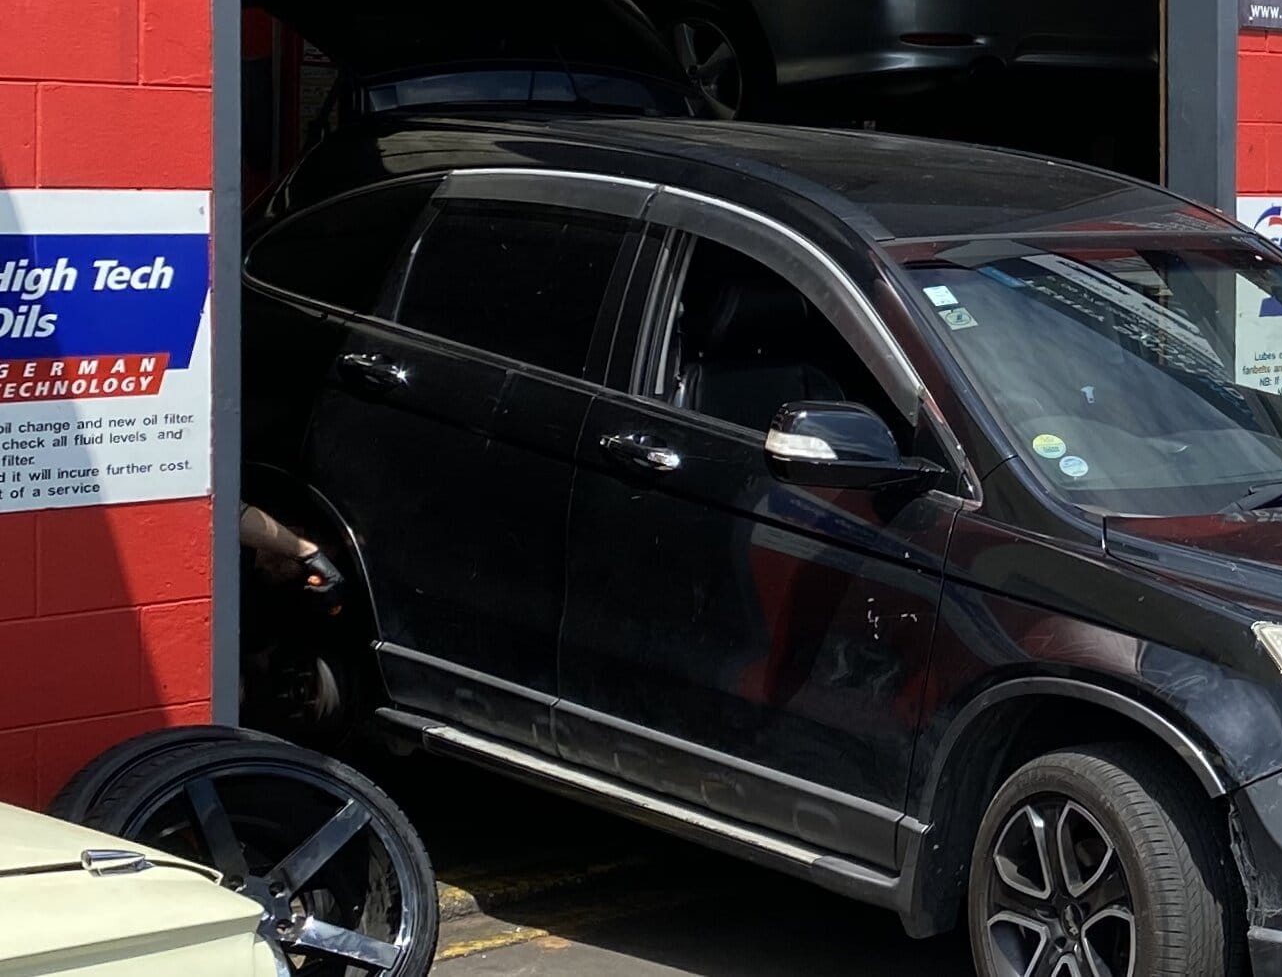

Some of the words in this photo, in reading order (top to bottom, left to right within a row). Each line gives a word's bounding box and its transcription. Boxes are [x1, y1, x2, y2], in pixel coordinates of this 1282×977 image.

[93, 256, 174, 291] Tech
[1254, 352, 1276, 361] Lubes
[0, 358, 156, 379] GERMAN
[0, 376, 153, 398] ECHNOLOGY
[19, 421, 70, 434] change
[77, 418, 102, 429] and
[109, 417, 136, 428] new
[143, 414, 158, 425] oil
[2, 437, 45, 450] check
[52, 436, 67, 447] all
[74, 434, 103, 446] fluid
[109, 432, 147, 444] levels
[157, 429, 183, 440] and
[12, 470, 21, 482] it
[29, 469, 51, 481] will
[57, 467, 99, 479] incure
[106, 463, 153, 475] further
[10, 487, 25, 499] of
[32, 488, 41, 497] a
[48, 483, 100, 497] service
